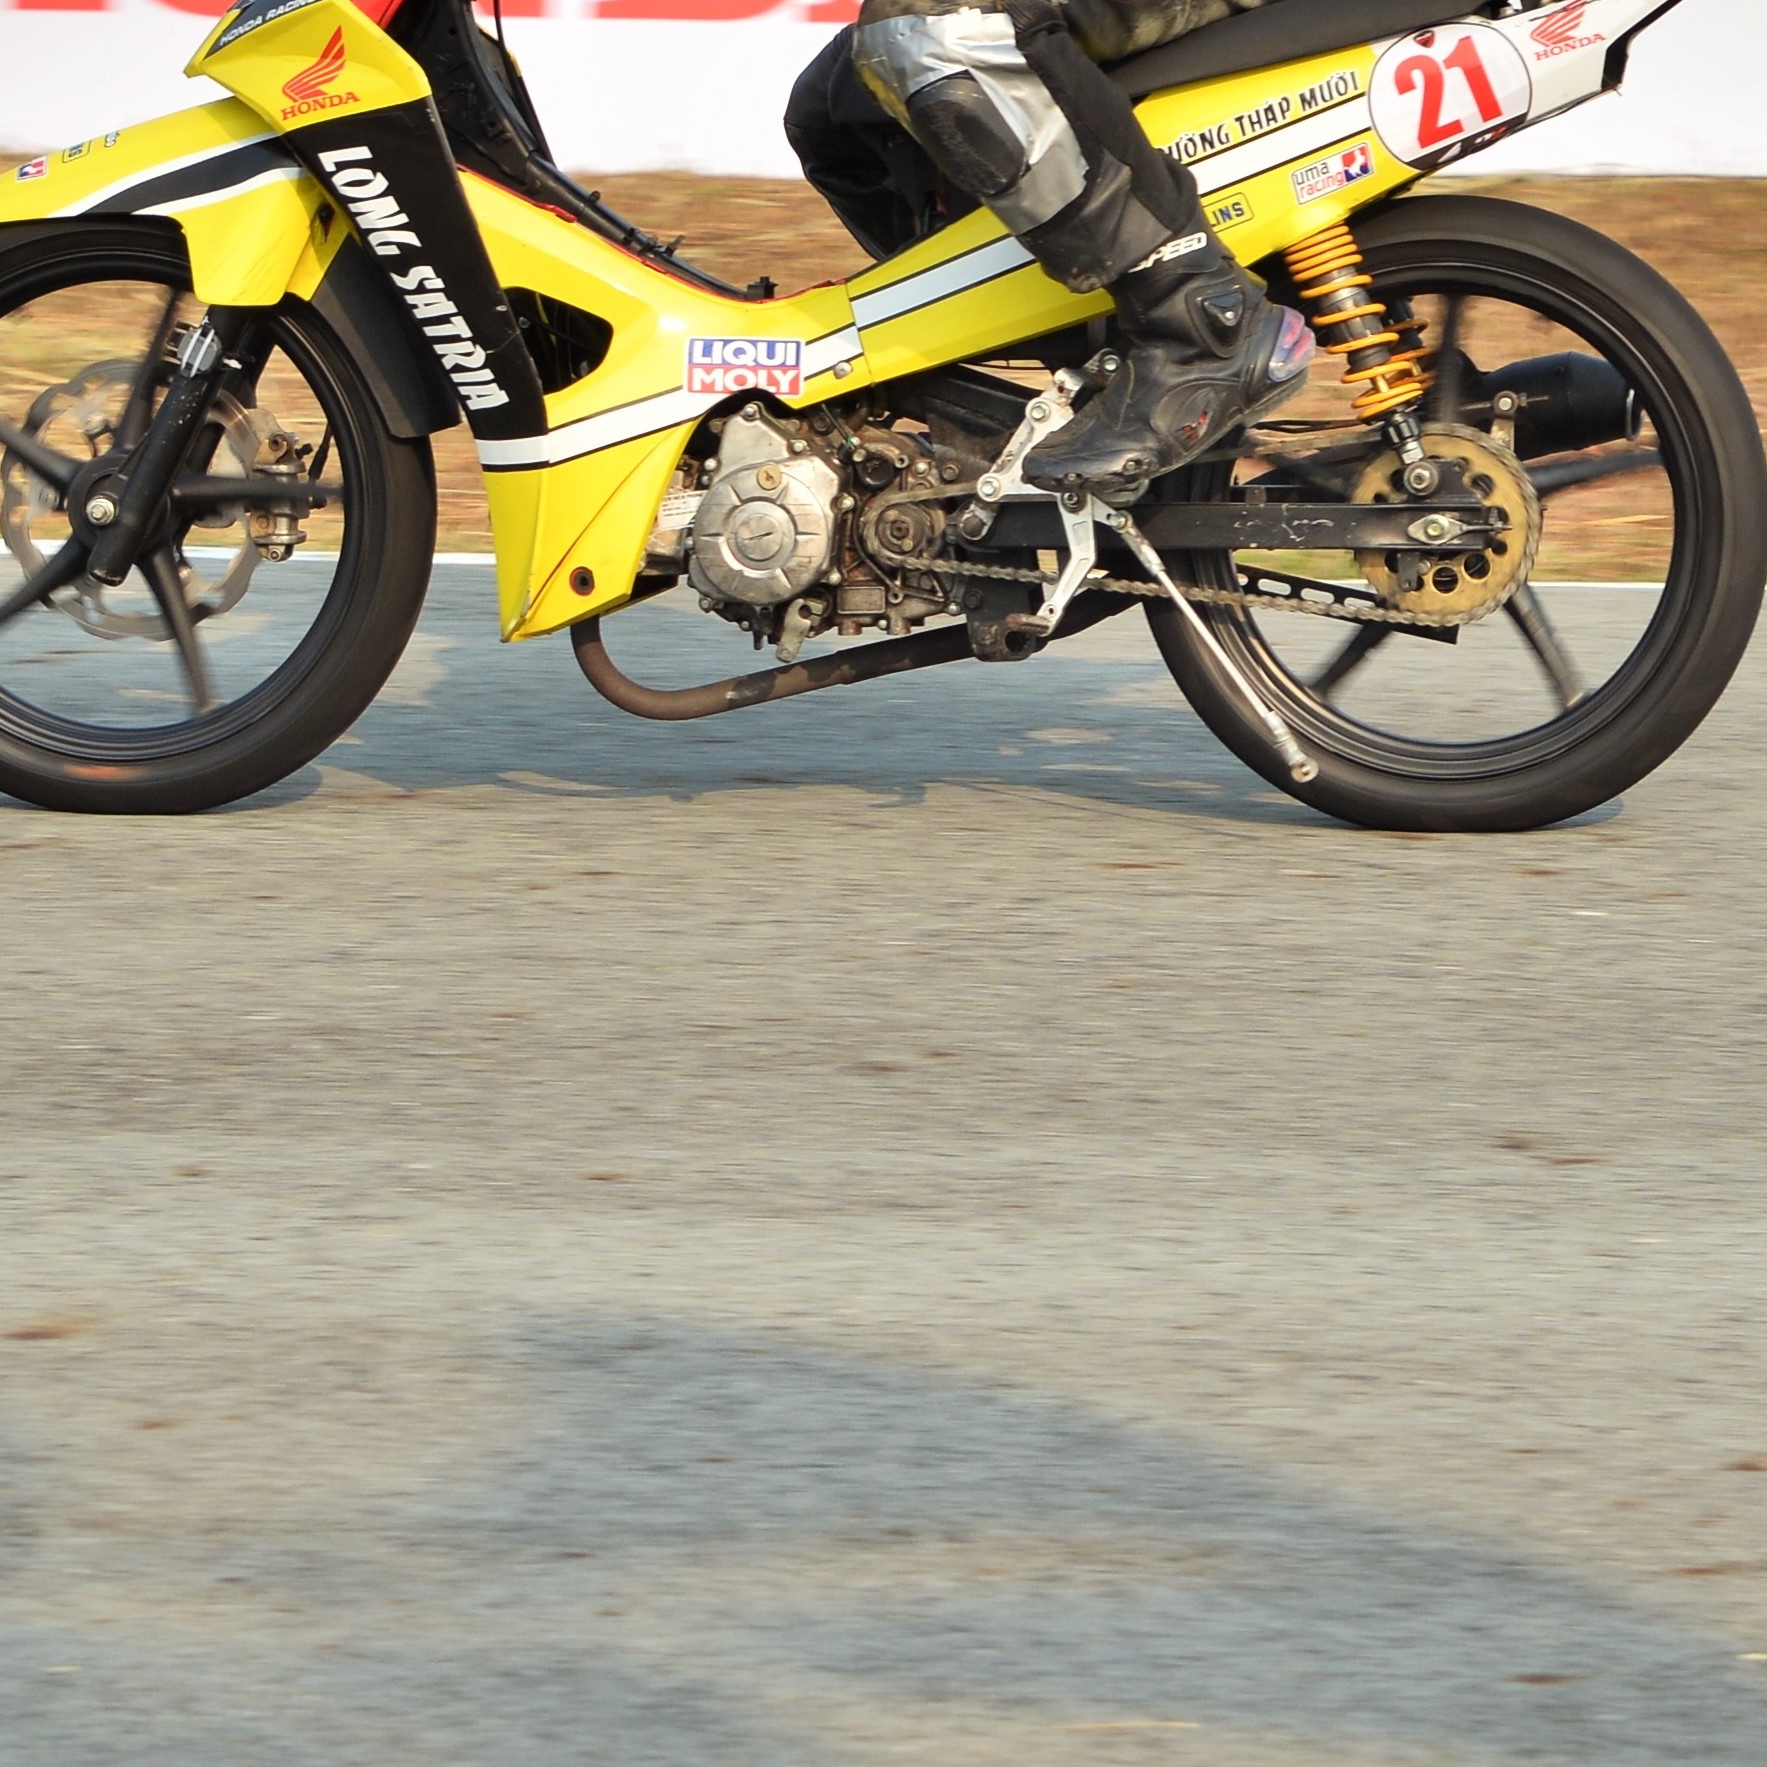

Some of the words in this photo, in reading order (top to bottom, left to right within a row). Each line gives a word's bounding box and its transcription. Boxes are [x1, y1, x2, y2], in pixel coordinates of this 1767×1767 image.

[219, 15, 263, 46] HONDA
[1533, 32, 1607, 62] HONDA
[281, 91, 361, 121] HONDA
[1393, 34, 1504, 150] 21
[1234, 95, 1292, 138] THÁP
[1294, 161, 1330, 186] uma
[1299, 171, 1345, 199] racing
[1211, 201, 1245, 228] INS
[317, 145, 422, 255] LONG
[389, 265, 510, 411] SATRIA
[692, 340, 798, 367] LIQUI
[692, 368, 800, 393] MOLY
